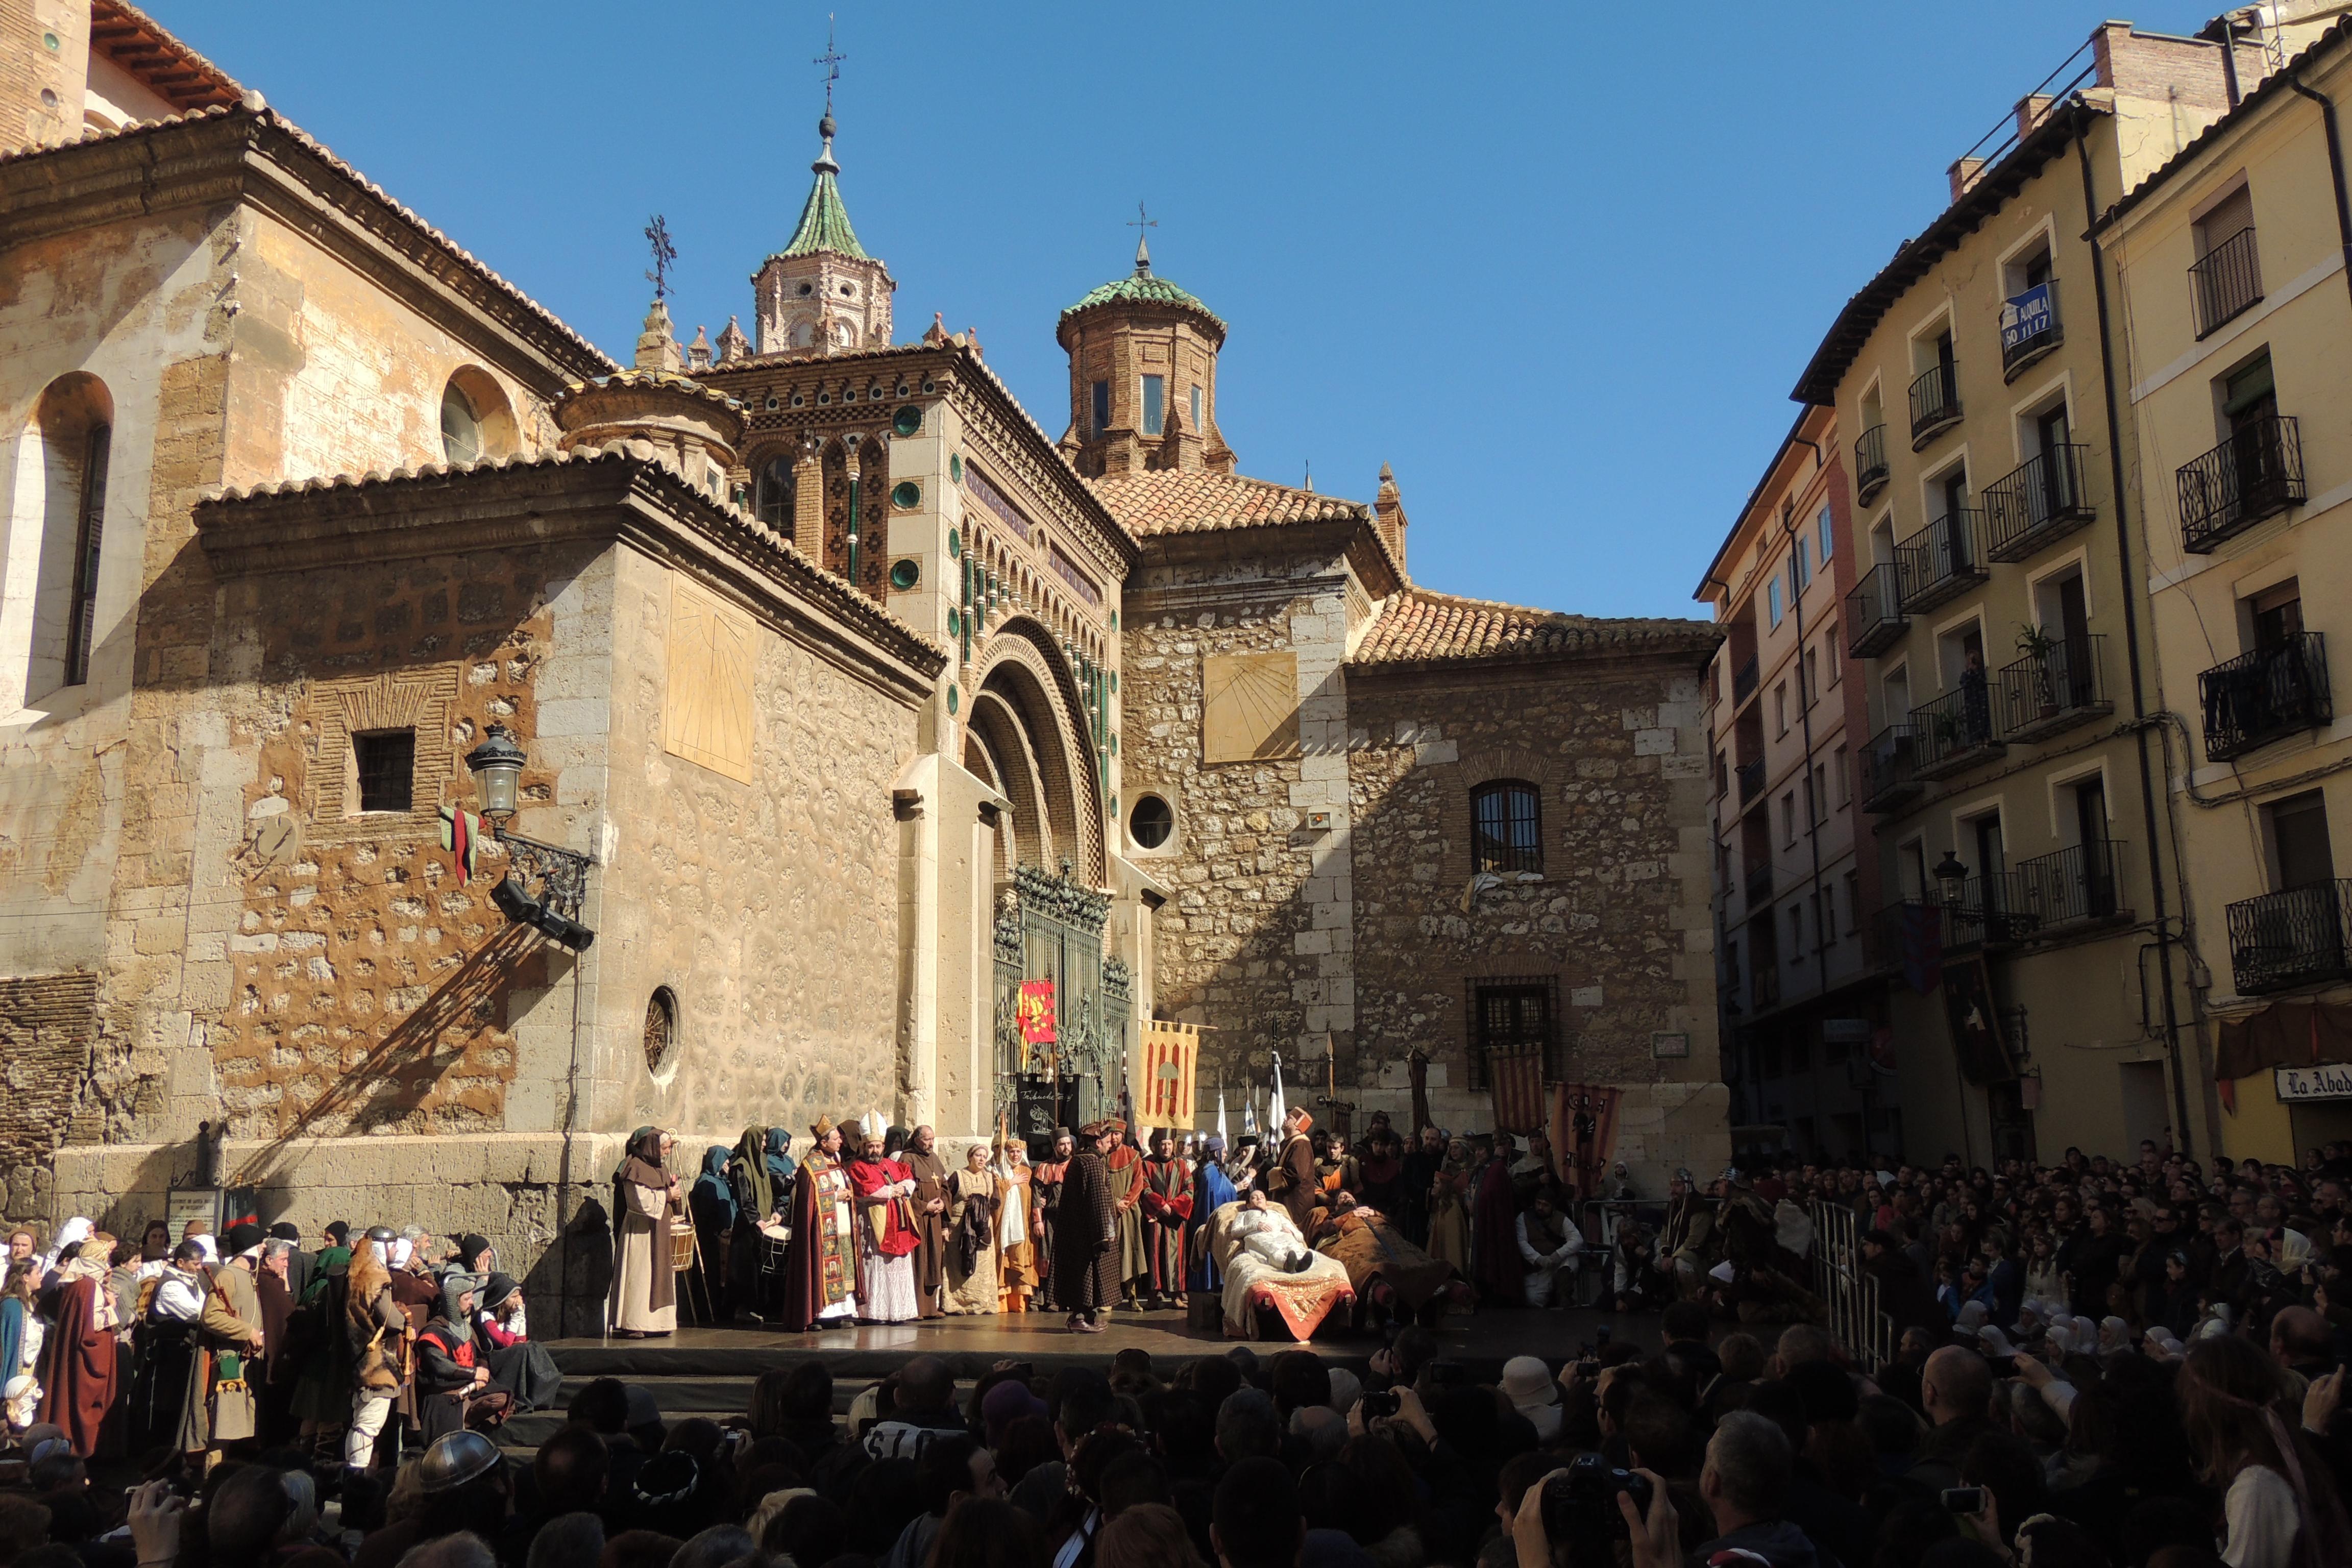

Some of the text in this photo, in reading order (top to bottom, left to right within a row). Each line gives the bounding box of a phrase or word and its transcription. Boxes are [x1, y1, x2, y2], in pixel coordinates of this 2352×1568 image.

[2020, 297, 2048, 323] ALQUILA
[2022, 323, 2031, 338] 11
[2034, 314, 2047, 331] 17
[2287, 1072, 2308, 1094] La
